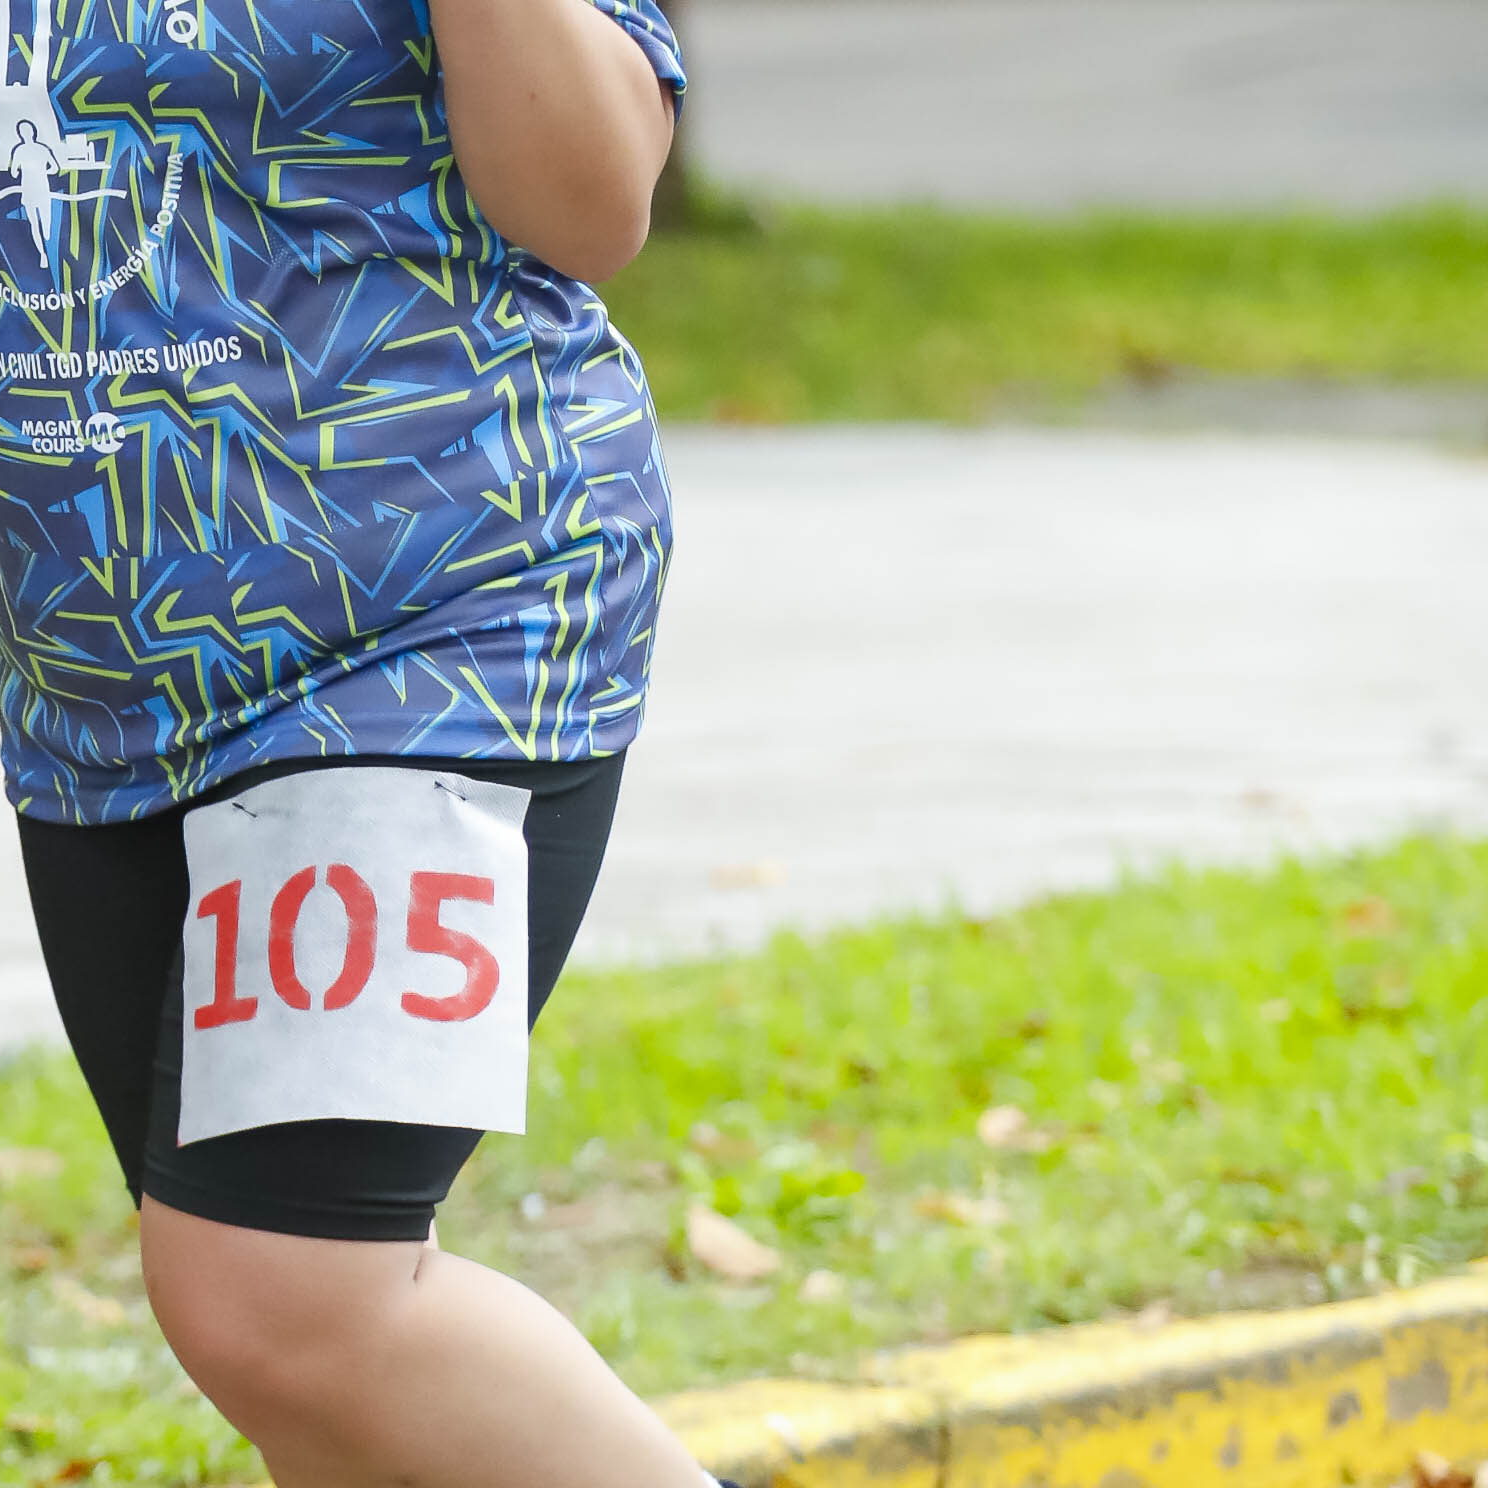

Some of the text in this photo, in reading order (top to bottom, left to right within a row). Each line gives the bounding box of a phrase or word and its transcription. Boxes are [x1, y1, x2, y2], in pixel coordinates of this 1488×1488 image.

[77, 288, 87, 305] Y
[89, 238, 160, 300] ENERGÍA
[150, 152, 184, 239] POSITIVA
[8, 351, 46, 380] CIVIL
[49, 352, 83, 380] TGD
[86, 347, 159, 377] PADRES
[162, 335, 243, 372] UNIDOS
[21, 419, 83, 437] MAGNY
[31, 437, 84, 454] COURS
[194, 863, 500, 1031] 105
